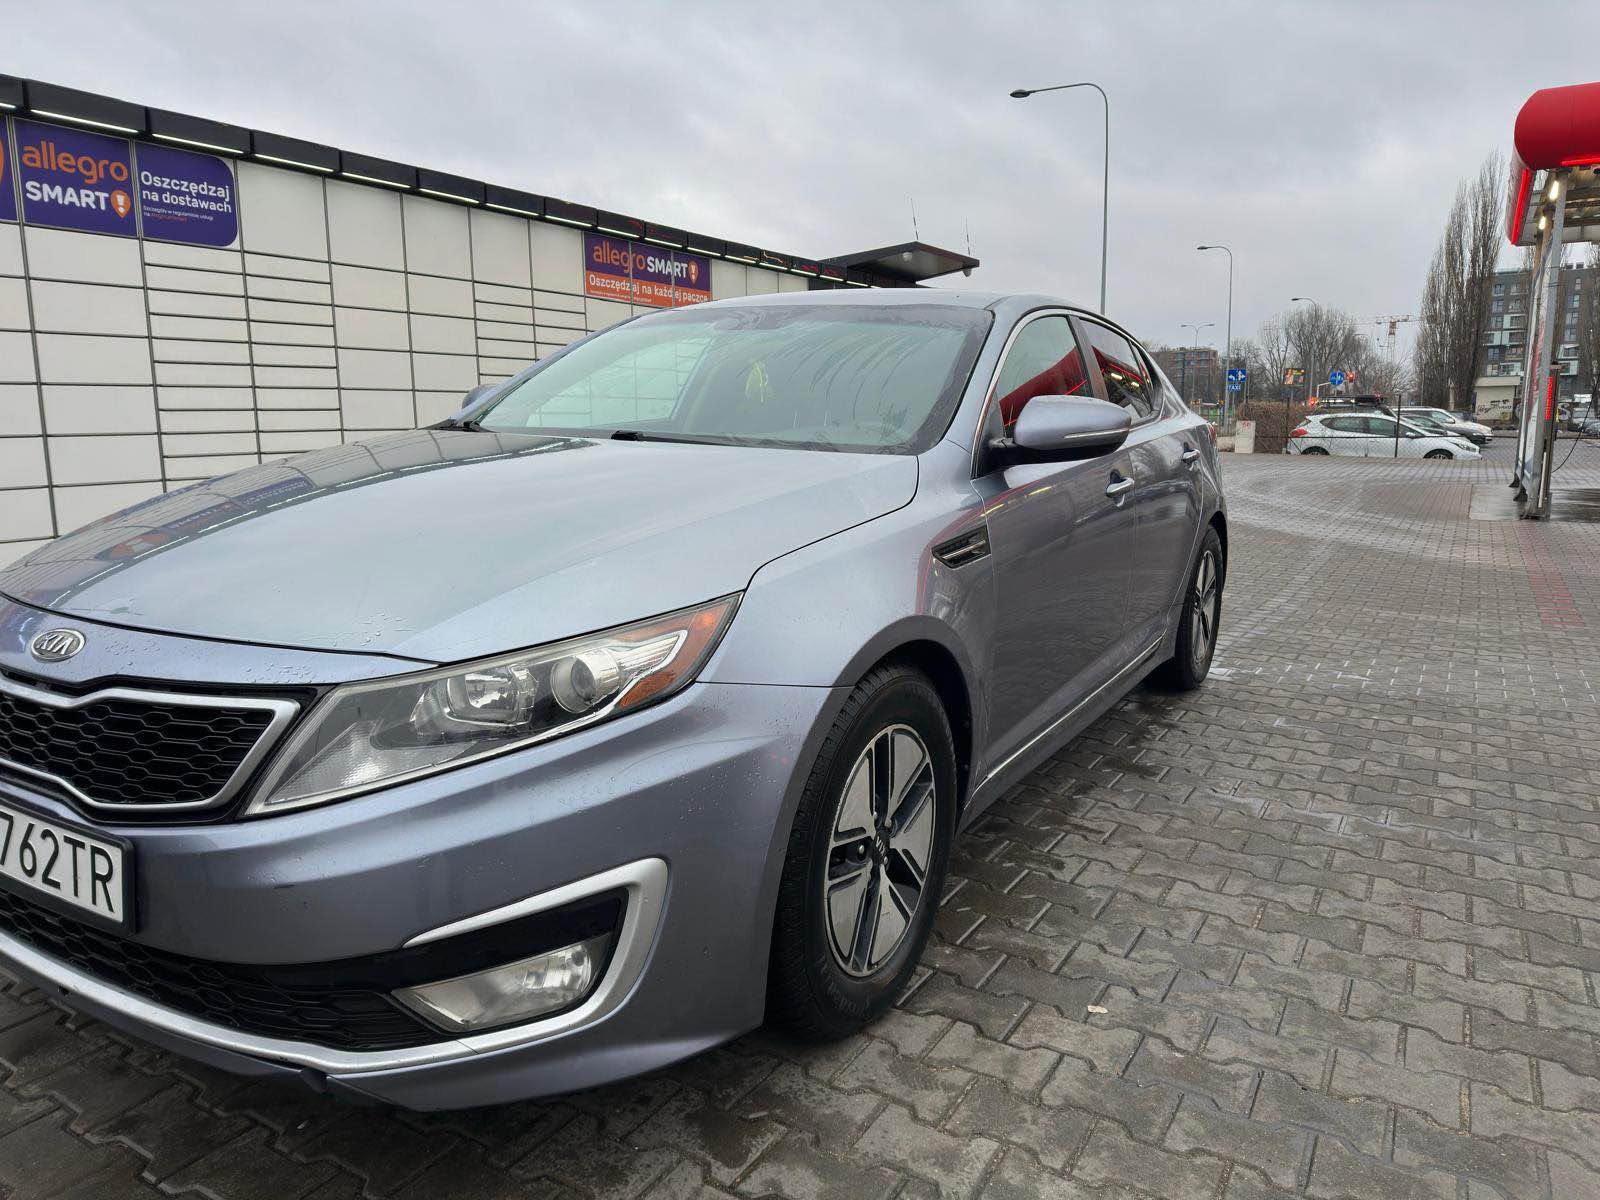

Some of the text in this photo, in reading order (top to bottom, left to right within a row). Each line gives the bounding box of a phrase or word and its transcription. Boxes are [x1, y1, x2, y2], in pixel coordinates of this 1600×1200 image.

[22, 140, 129, 184] allegro
[140, 171, 230, 202] Oszczędzaj
[142, 190, 232, 213] na dostawach
[593, 241, 646, 273] allegro
[589, 274, 640, 295] Oszczędzaj
[641, 284, 652, 295] na
[654, 285, 682, 302] każdej
[682, 291, 708, 303] paczce
[36, 633, 74, 655] KIA
[0, 810, 114, 913] 762TR
